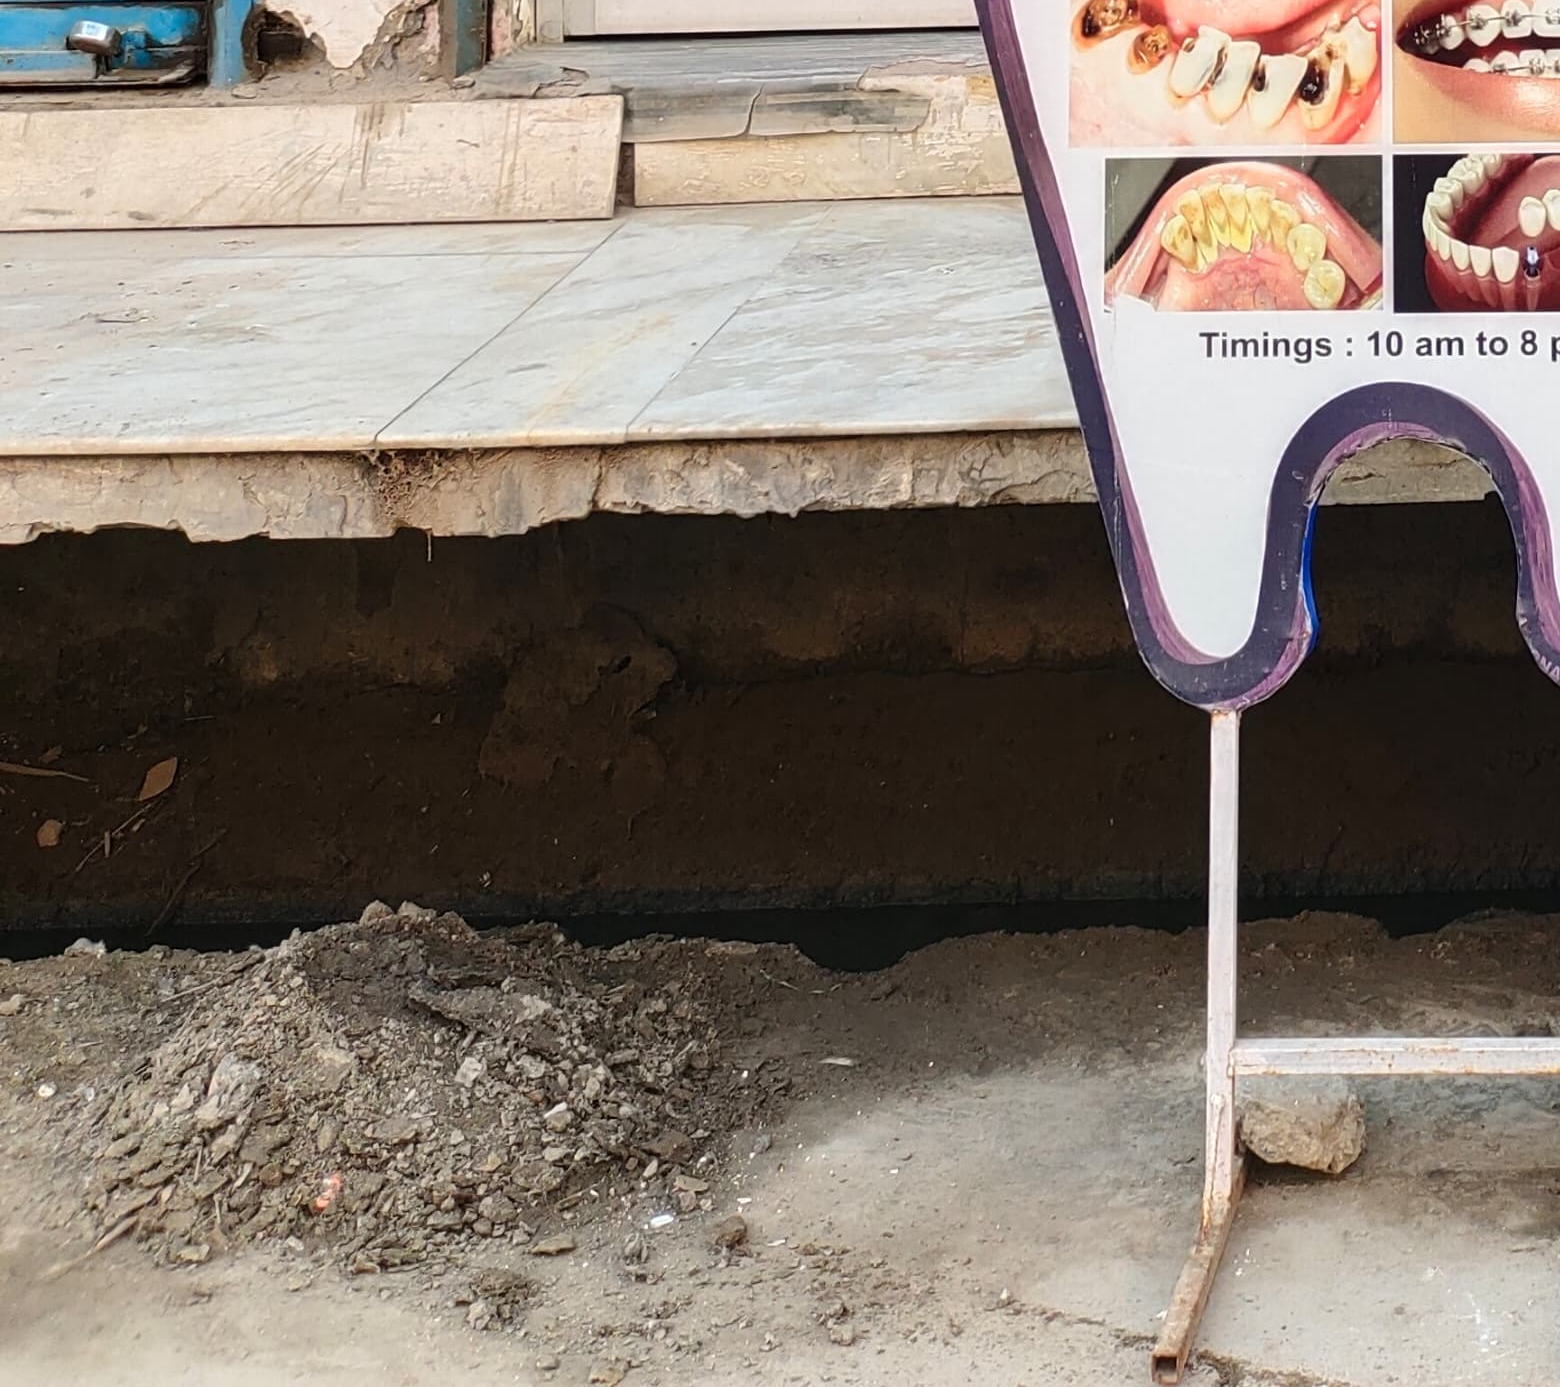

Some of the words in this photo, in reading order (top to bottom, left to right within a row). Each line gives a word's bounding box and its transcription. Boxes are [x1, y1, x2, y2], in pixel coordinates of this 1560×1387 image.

[1200, 330, 1333, 364] Timings
[1366, 330, 1404, 359] 10
[1414, 335, 1466, 359] am
[1474, 332, 1508, 358] to
[1519, 330, 1539, 358] 8
